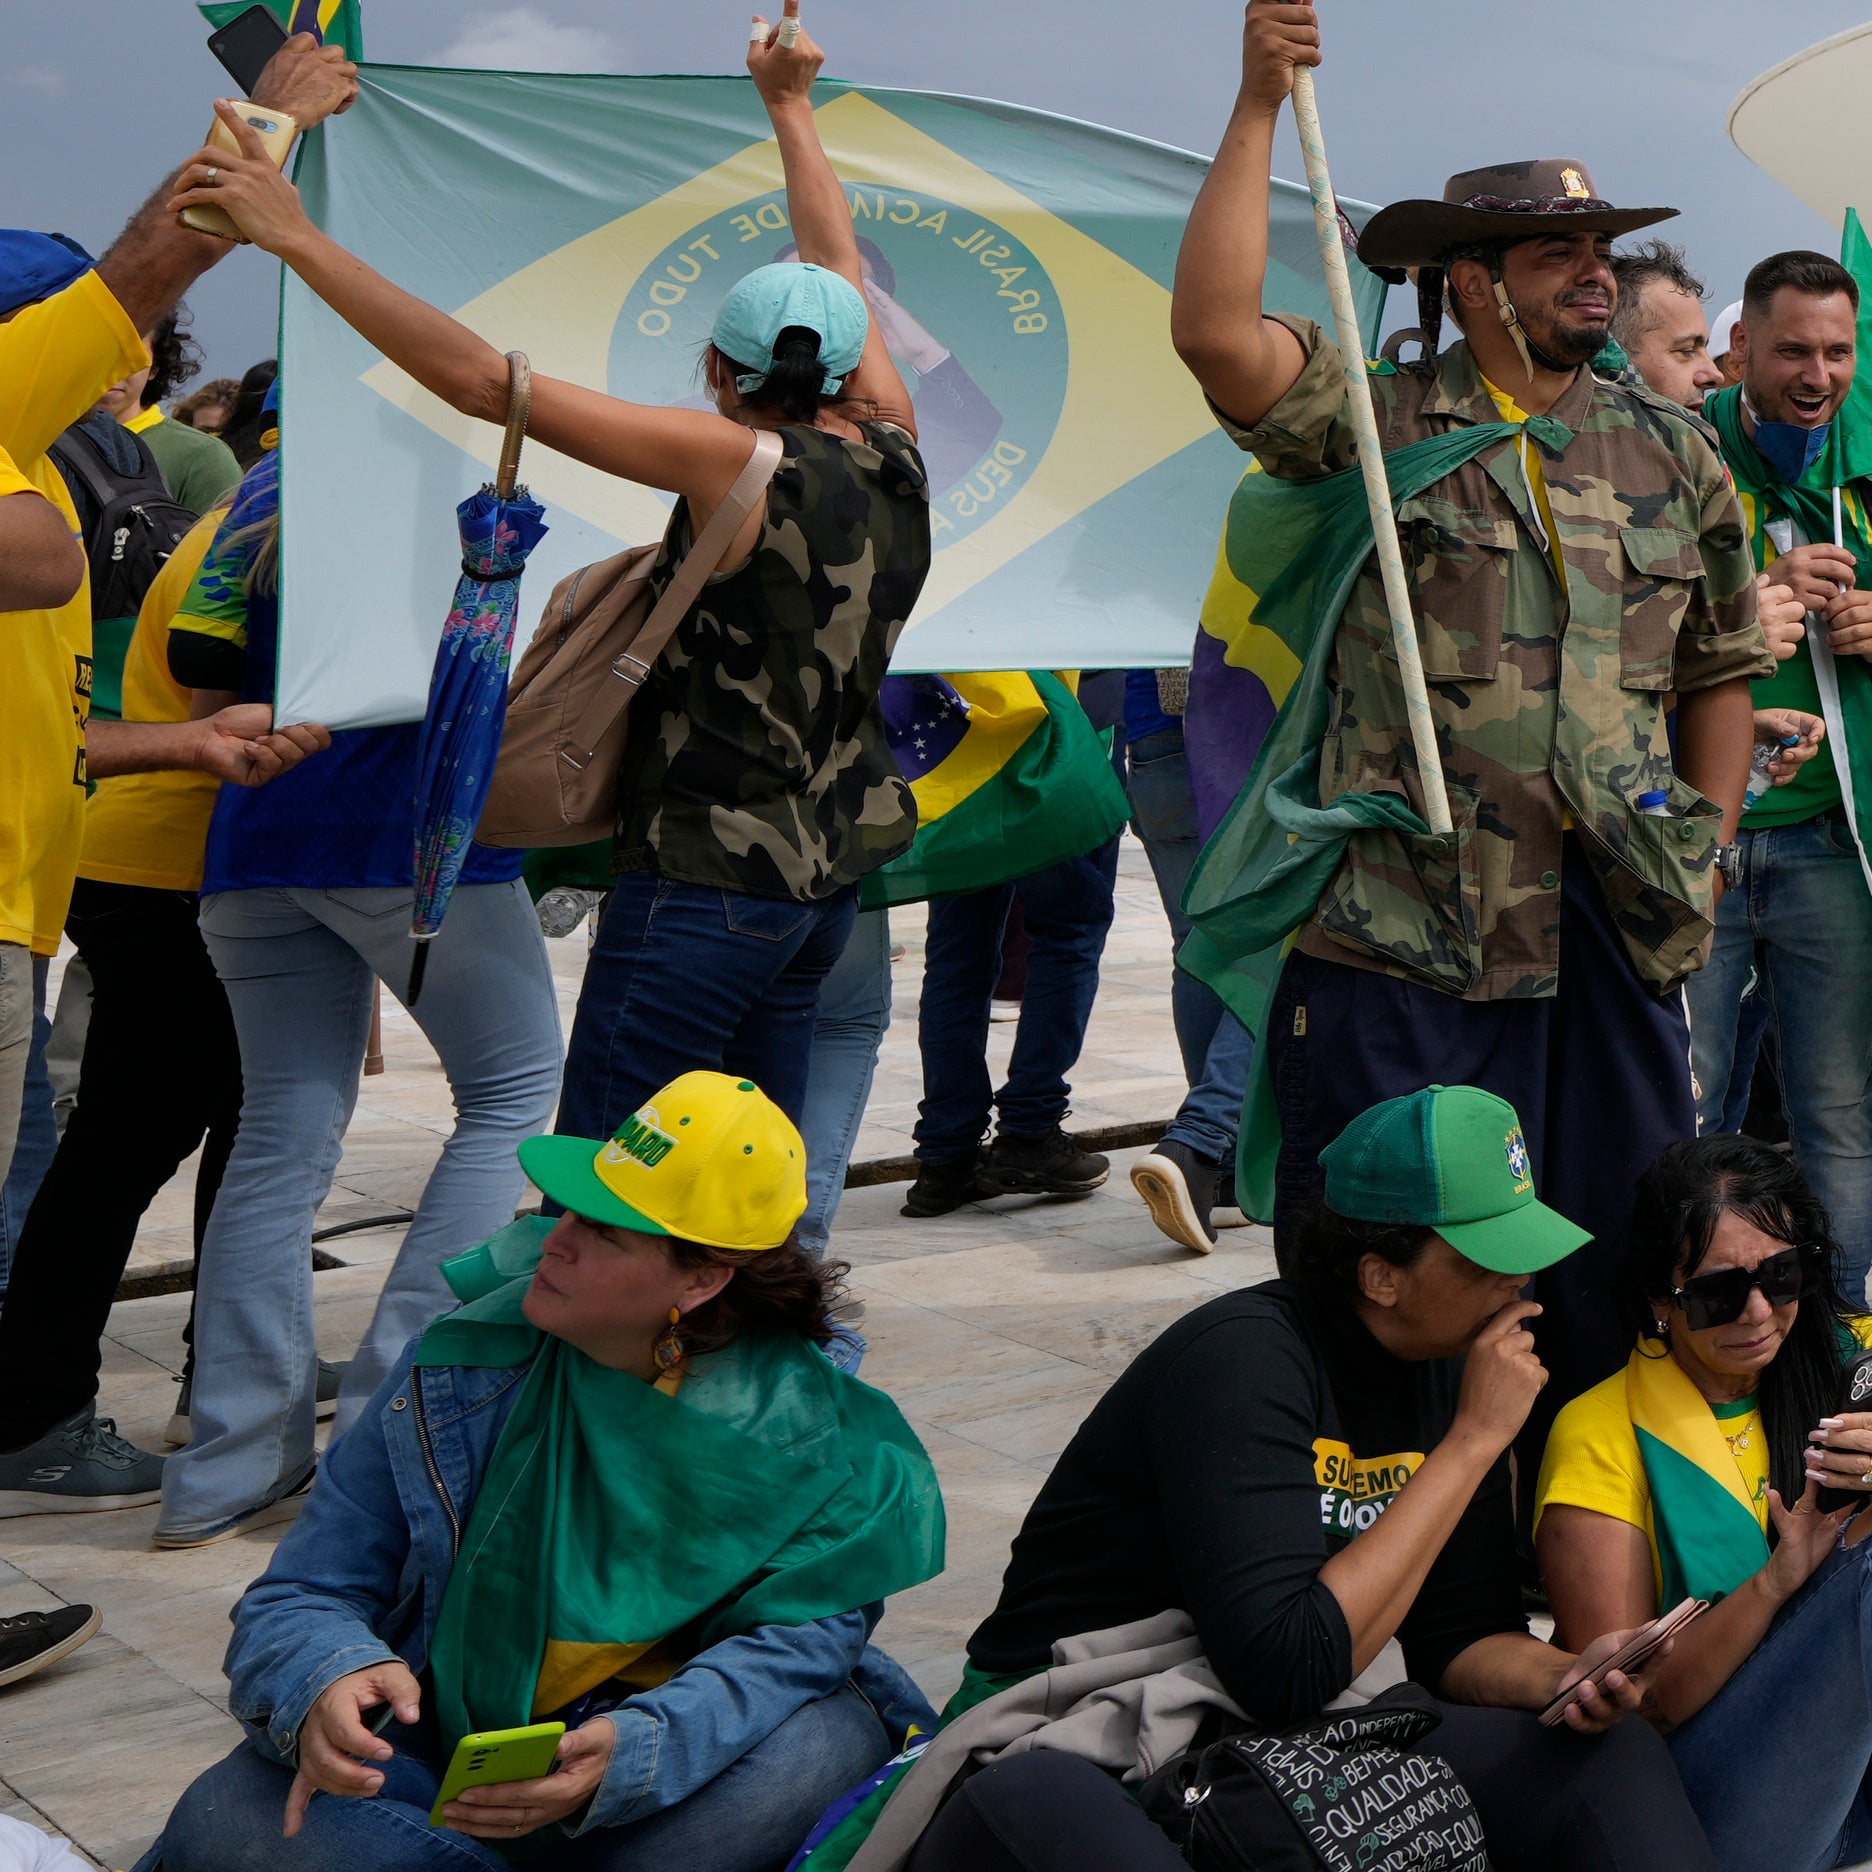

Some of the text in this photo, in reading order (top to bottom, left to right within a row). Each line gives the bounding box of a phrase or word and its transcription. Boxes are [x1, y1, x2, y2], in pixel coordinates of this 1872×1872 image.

[1320, 1487, 1336, 1525] É
[1325, 1755, 1440, 1839] QUALIDADE
[1374, 1786, 1453, 1846] SEGURANÇA
